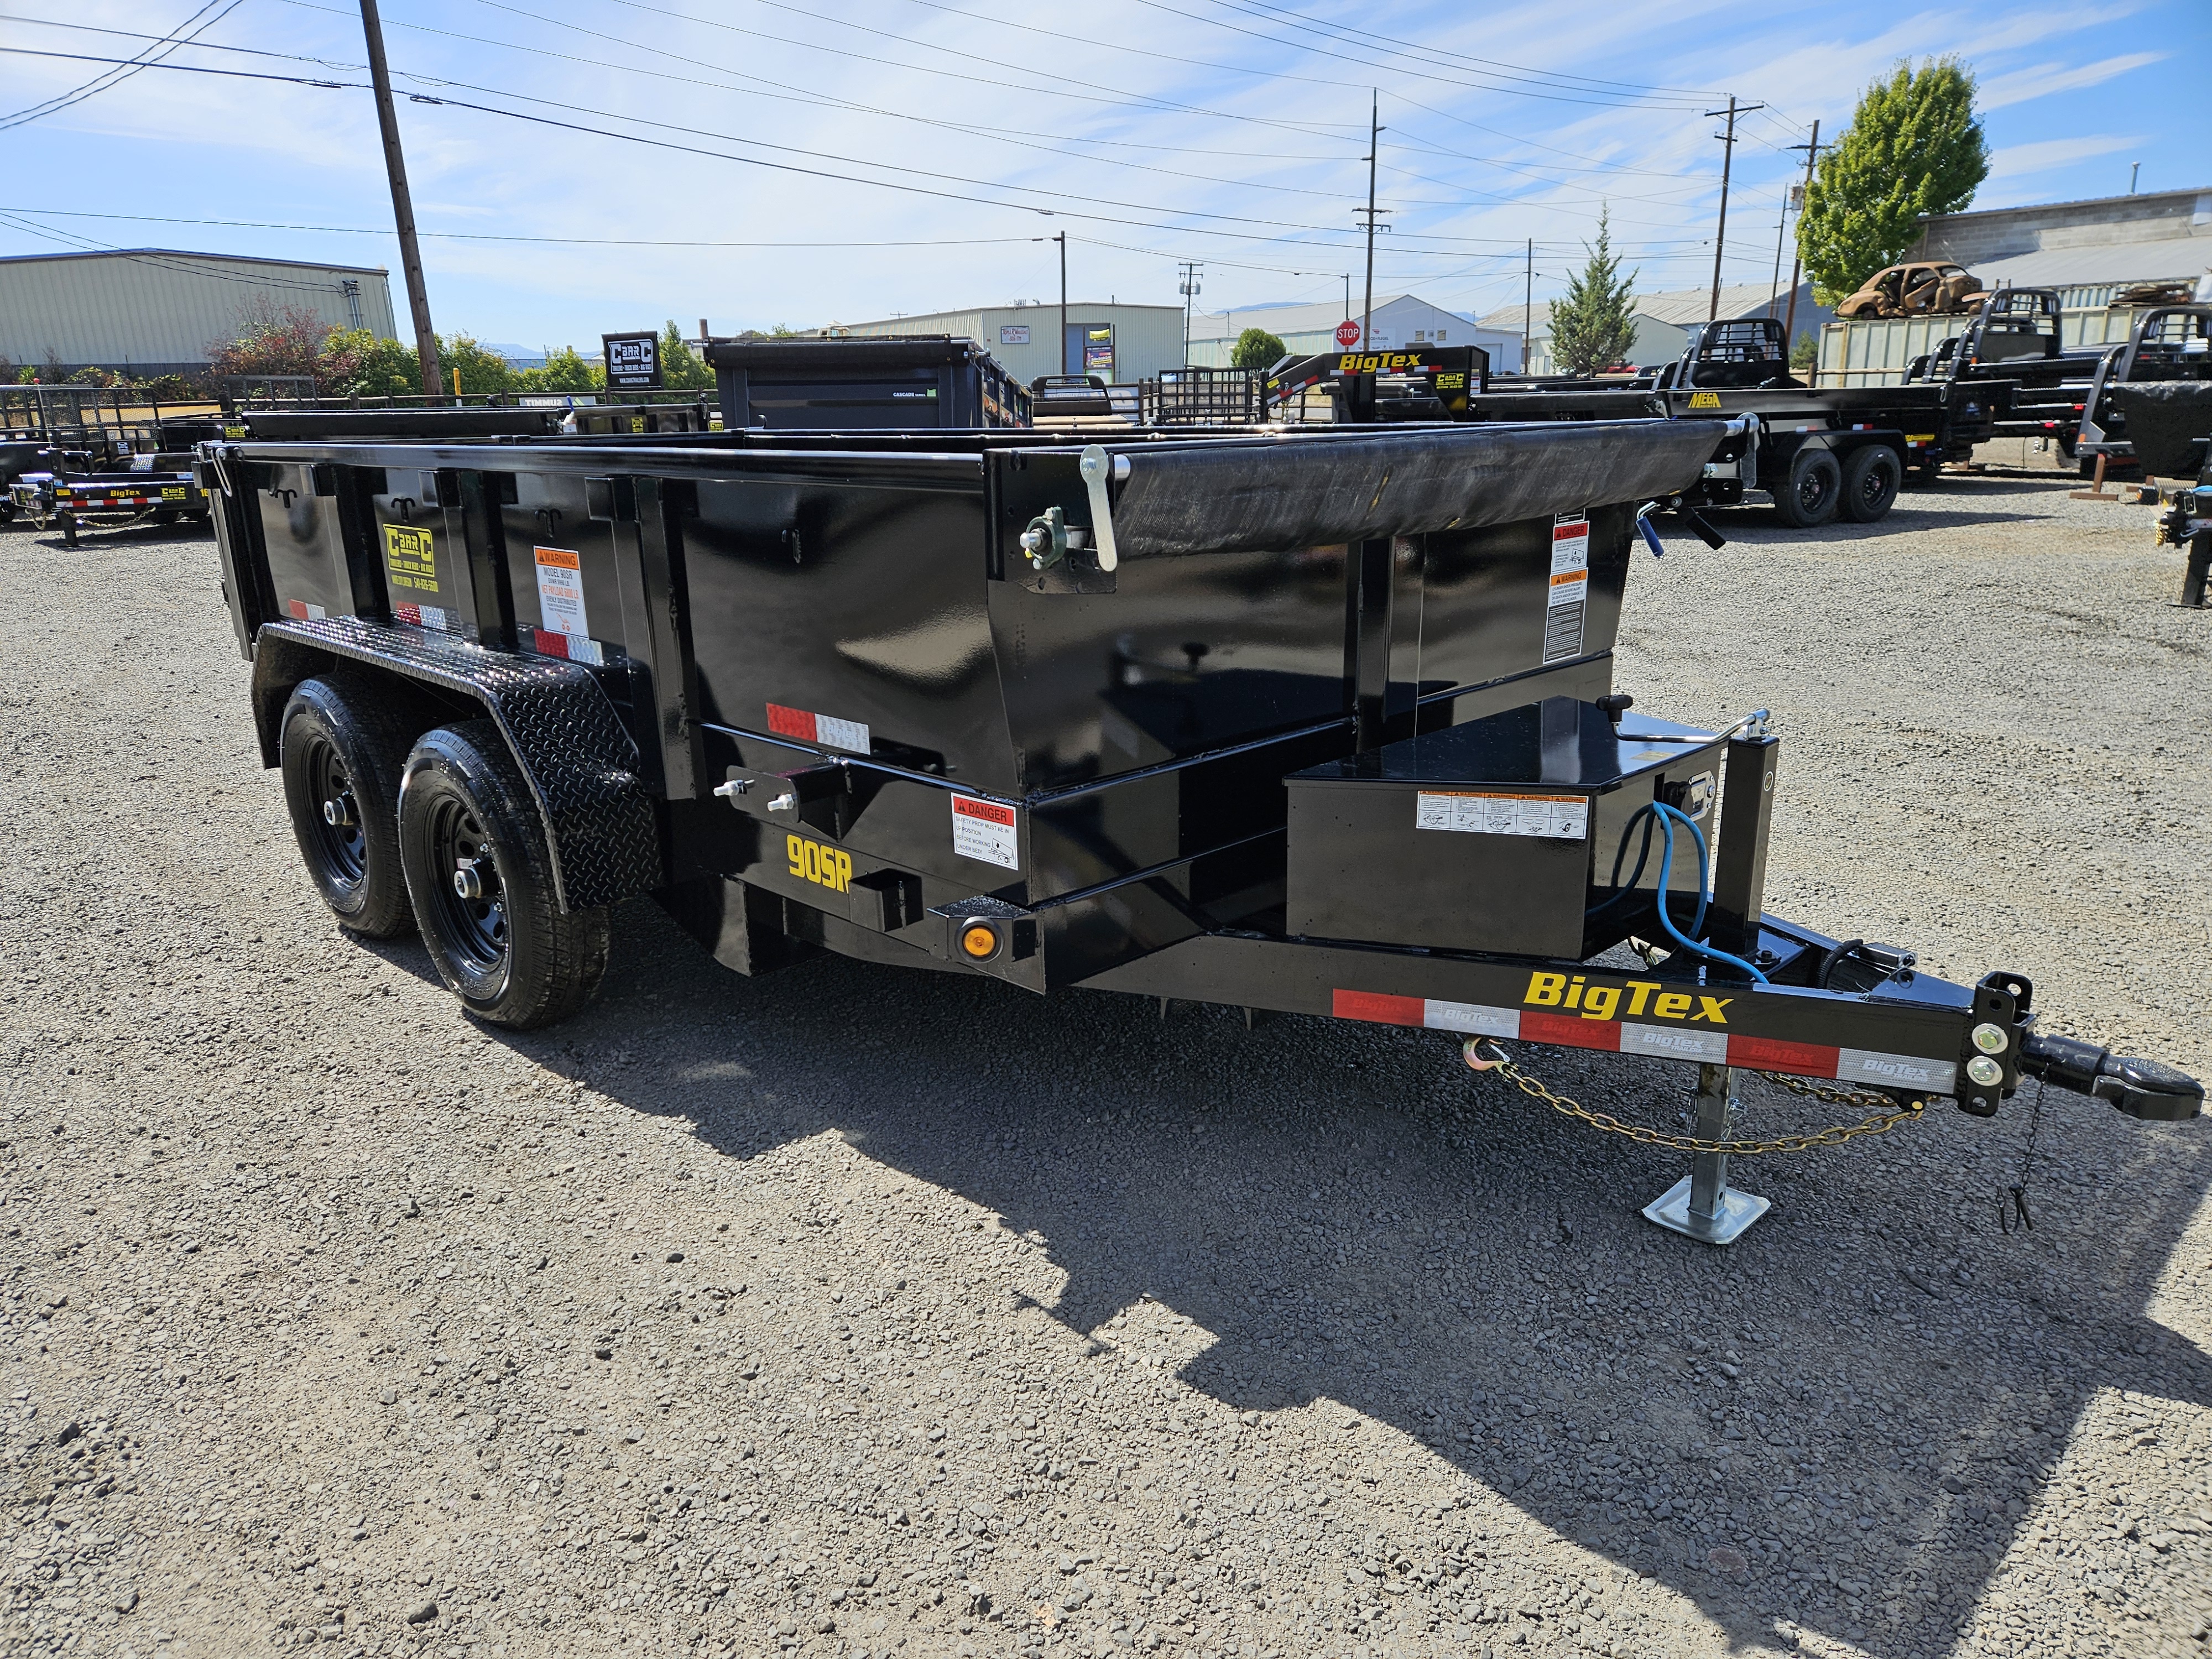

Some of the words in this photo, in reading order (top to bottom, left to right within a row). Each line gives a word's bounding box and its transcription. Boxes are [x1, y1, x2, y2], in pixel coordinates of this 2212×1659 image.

[1338, 328, 1359, 338] STOP
[1339, 352, 1421, 373] BigTex
[1688, 393, 1721, 408] MEGA
[1562, 525, 1584, 537] DANGER
[544, 553, 576, 565] WARNING
[543, 566, 560, 578] MODEL
[560, 568, 573, 580] 90SR
[1561, 572, 1581, 582] WARNING
[549, 585, 564, 597] PAYLOAD
[968, 804, 1006, 822] DANGER
[956, 816, 971, 825] SAFETY
[962, 827, 982, 836] POSITION
[957, 834, 971, 843] BEFORE
[972, 838, 990, 847] WORKING
[787, 834, 852, 894] 90SR
[1524, 972, 1734, 1024] BigTex
[1444, 1009, 1498, 1023] BigTex
[1643, 1033, 1704, 1048] BigTex
[1863, 1060, 1930, 1077] BigTex
